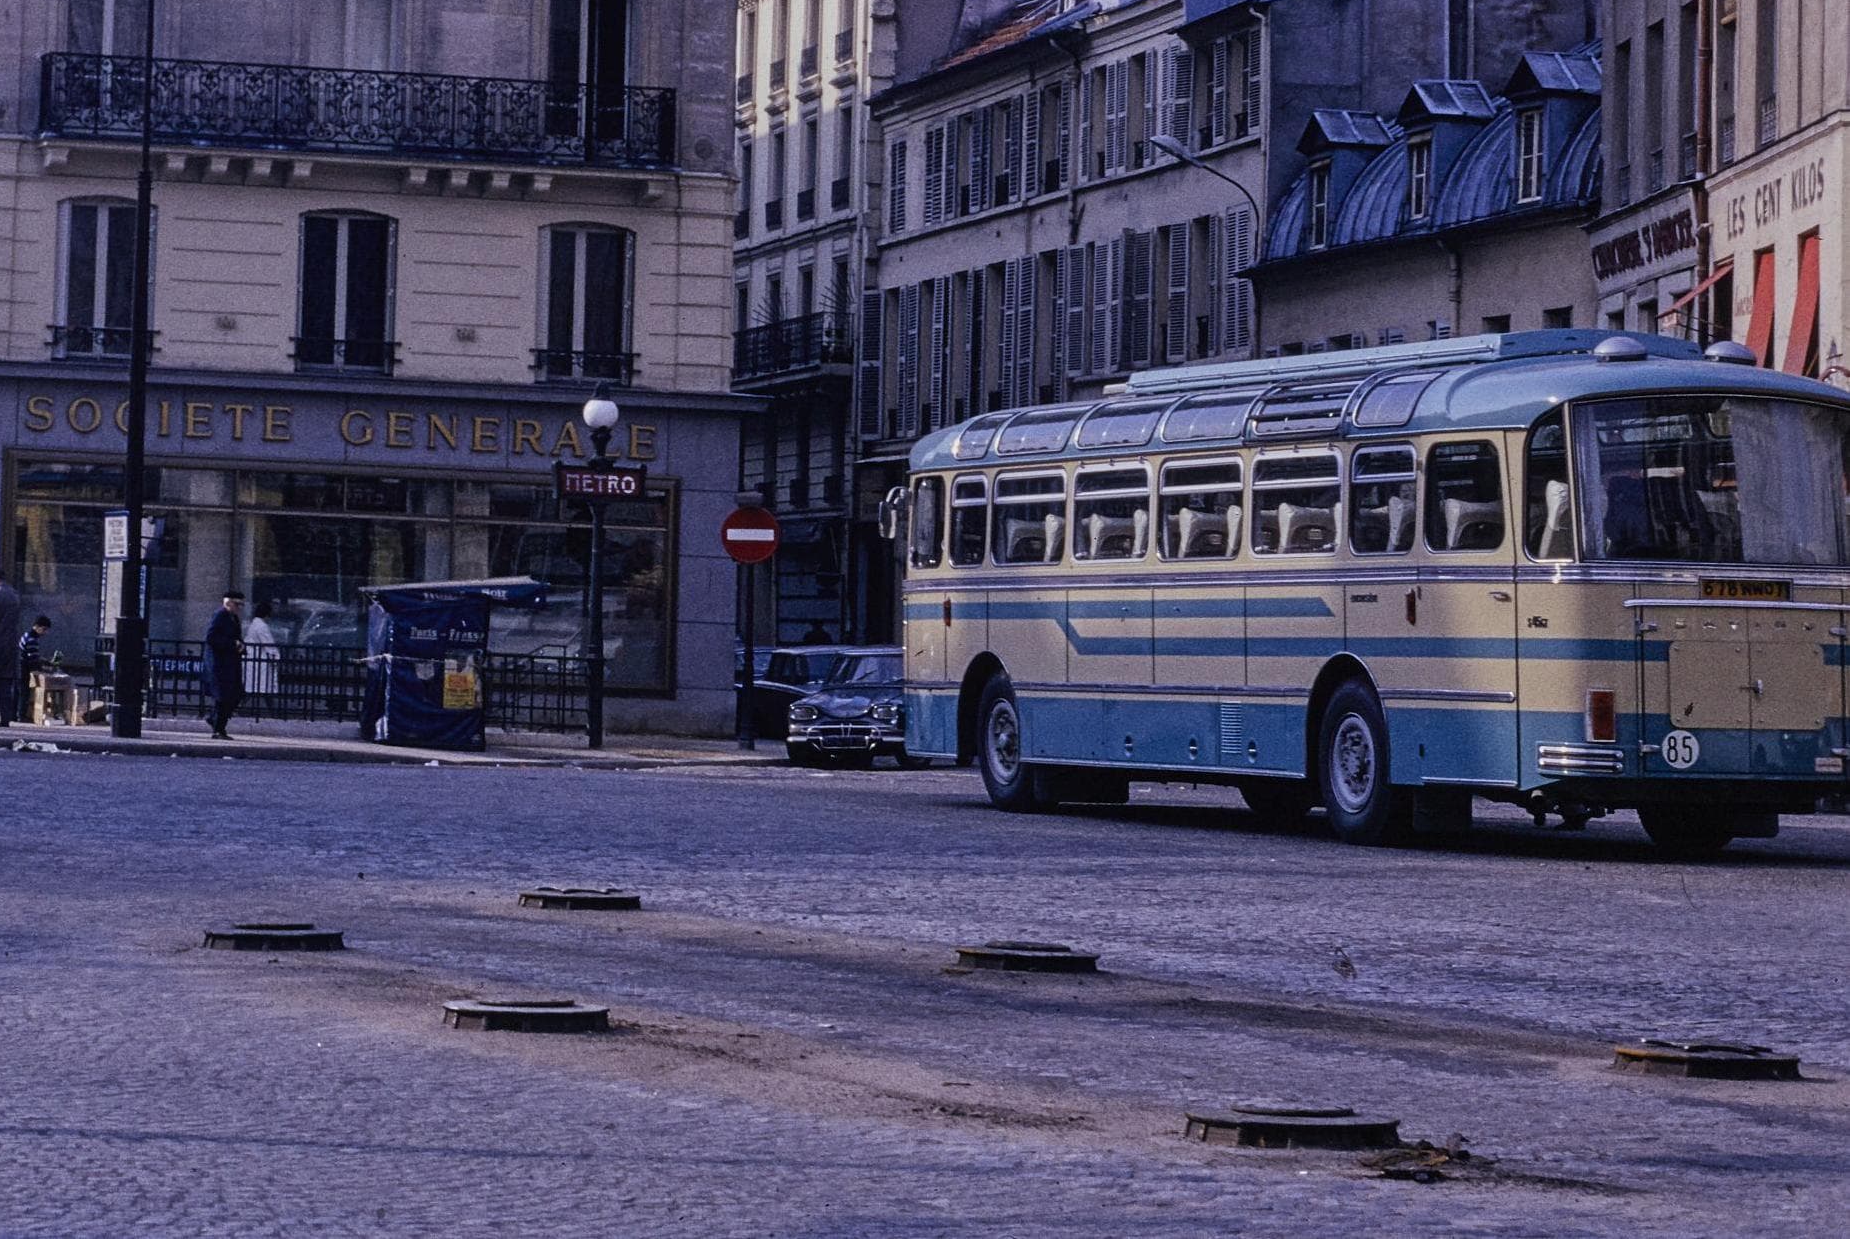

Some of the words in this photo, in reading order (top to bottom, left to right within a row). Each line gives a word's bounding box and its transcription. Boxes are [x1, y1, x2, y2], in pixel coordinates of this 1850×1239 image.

[1727, 195, 1745, 240] LES
[1755, 177, 1782, 229] CENT
[1791, 157, 1825, 212] KILOS
[1667, 735, 1693, 764] 85
